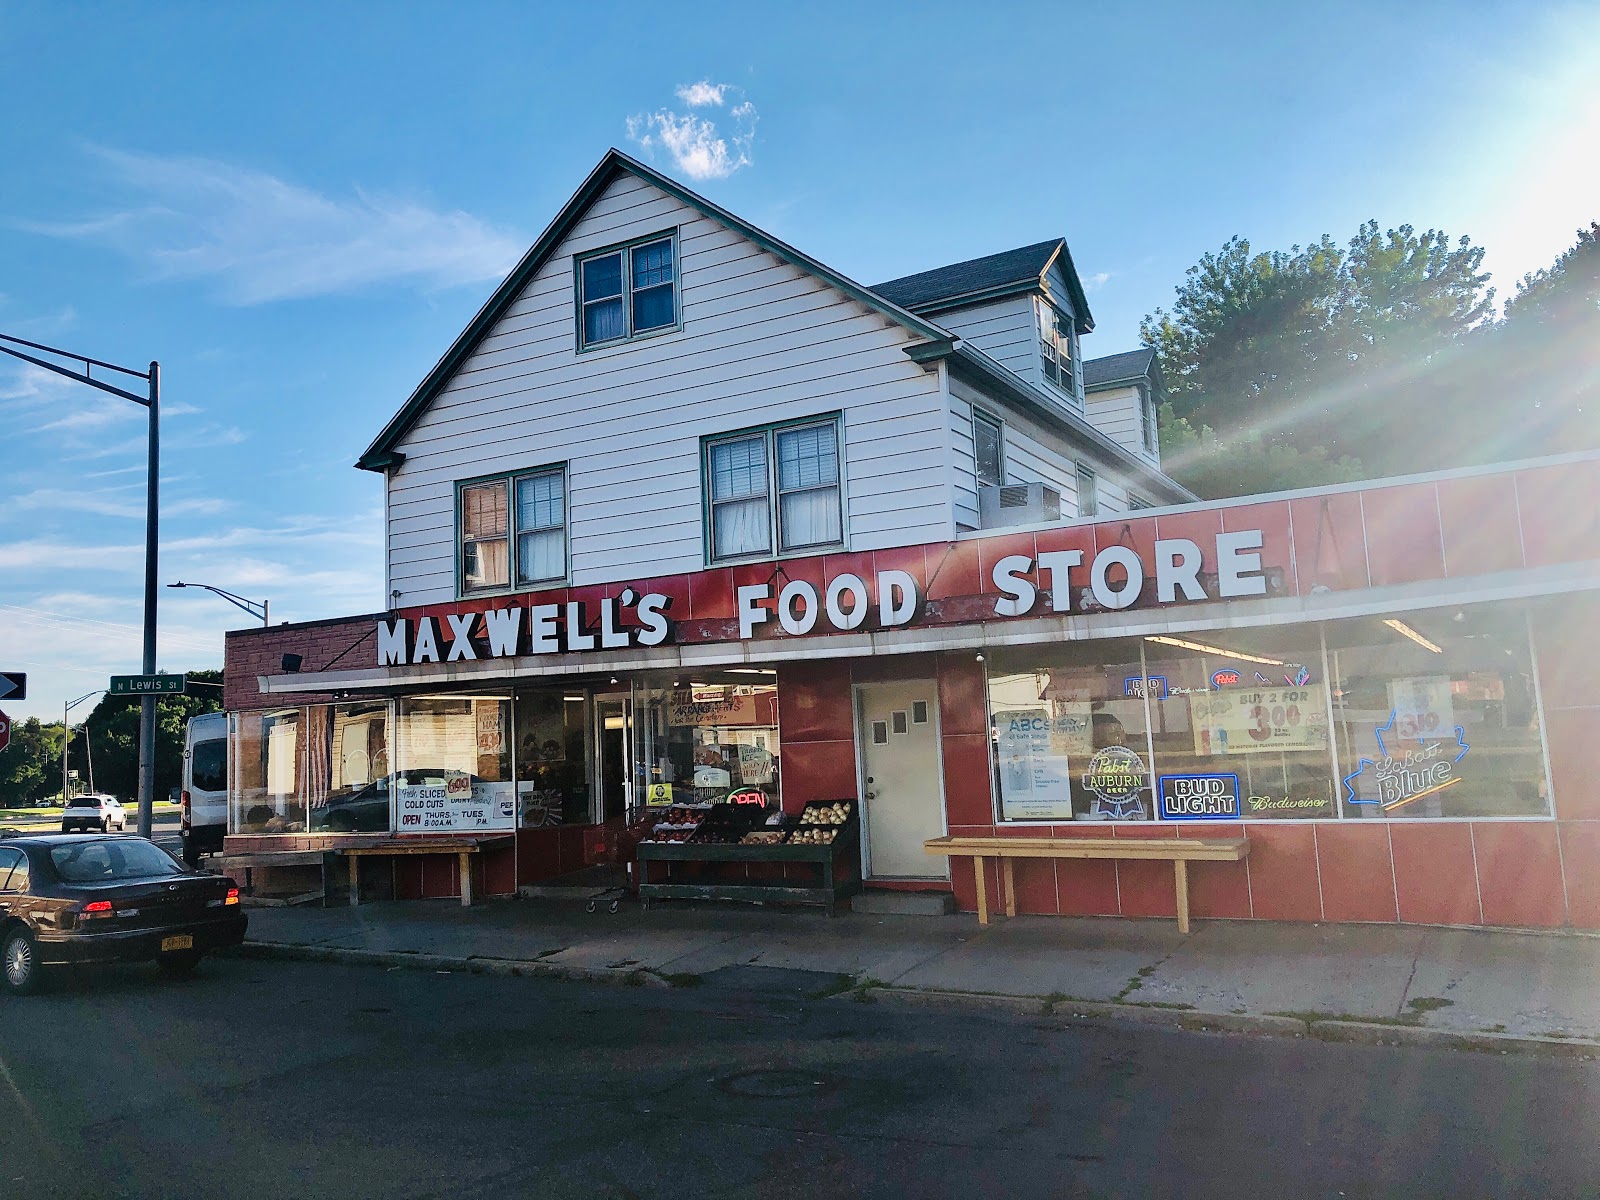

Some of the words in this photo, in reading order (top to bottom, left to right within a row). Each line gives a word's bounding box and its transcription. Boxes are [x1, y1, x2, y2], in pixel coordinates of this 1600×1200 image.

[377, 587, 669, 666] MAXWELL'S
[737, 567, 917, 639] FOOD
[991, 528, 1268, 617] STORE
[117, 682, 124, 691] N
[129, 678, 162, 691] Lewis
[168, 681, 177, 690] St
[1215, 673, 1239, 685] Pabst
[1239, 693, 1265, 705] BUY
[1269, 693, 1277, 703] 2
[1281, 691, 1309, 703] FOR
[1009, 717, 1050, 732] ABCs
[1096, 756, 1133, 774] Pabst
[1089, 774, 1144, 788] AUBURN
[1174, 778, 1226, 797] BUD
[1376, 761, 1453, 807] Blue
[419, 789, 446, 799] SLICED
[728, 791, 766, 809] OPEN
[404, 800, 425, 809] COLD
[426, 799, 444, 809] CUTS
[1165, 795, 1236, 814] LIGHT
[1247, 795, 1329, 812] Budweiser
[402, 814, 422, 826] OPEN
[461, 810, 485, 818] TUES.
